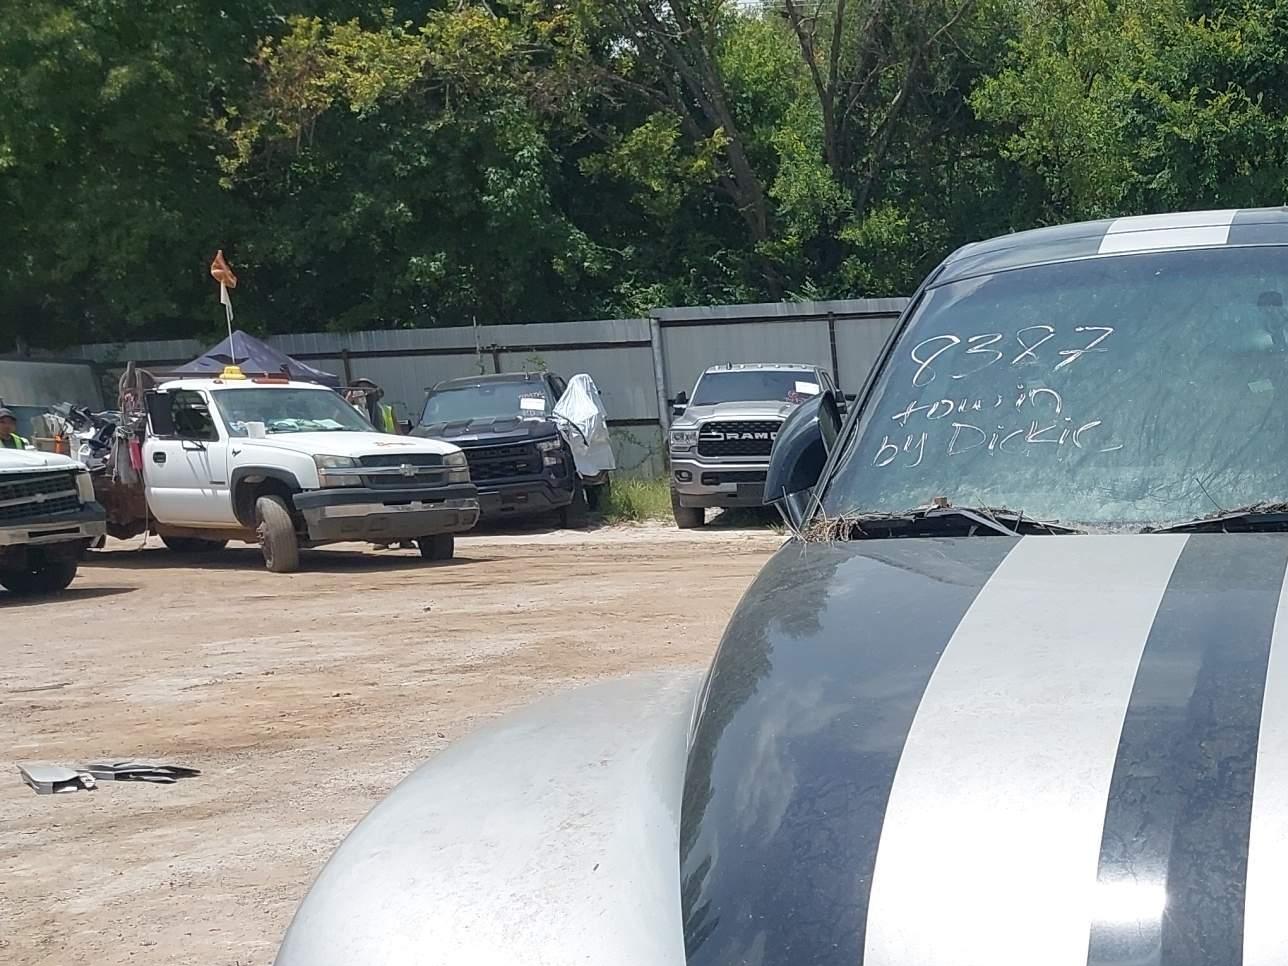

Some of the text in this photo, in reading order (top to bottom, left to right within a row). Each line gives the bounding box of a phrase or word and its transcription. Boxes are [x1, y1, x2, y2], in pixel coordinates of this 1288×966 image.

[910, 325, 1114, 388] 8387
[726, 432, 768, 440] RAM
[872, 434, 928, 468] by
